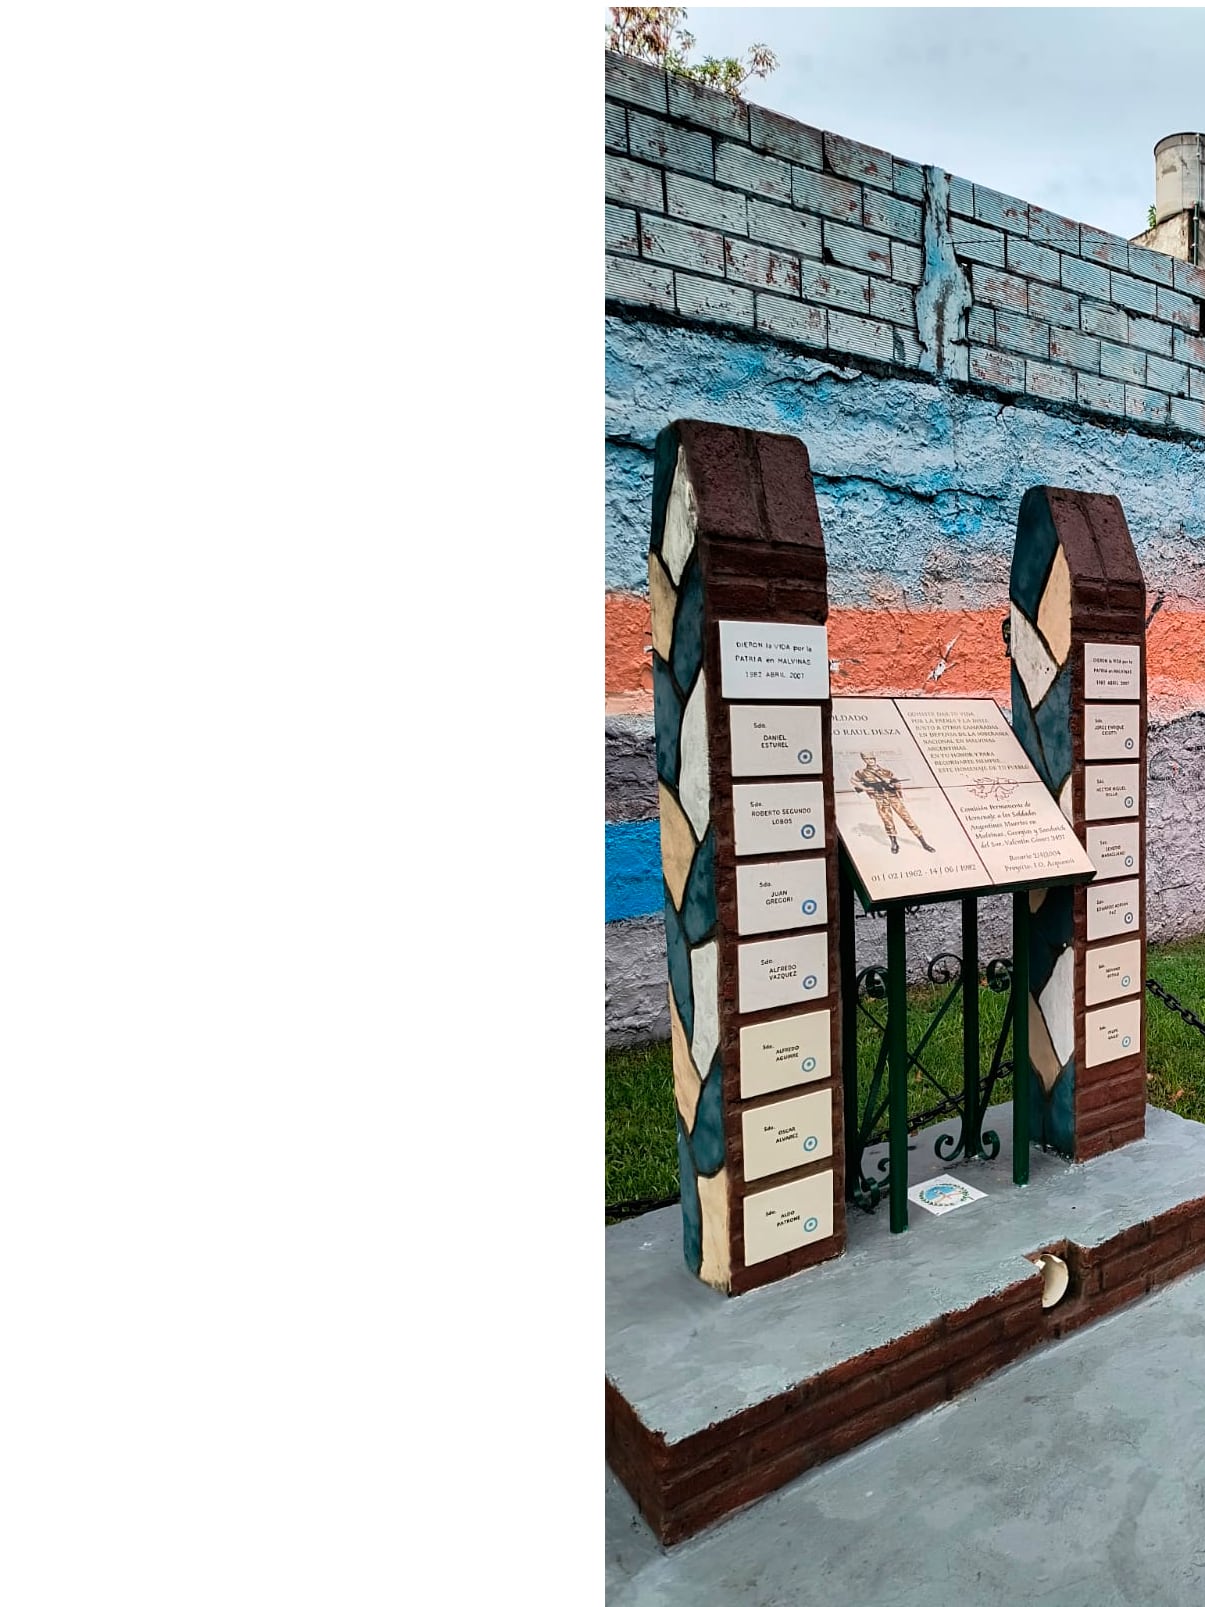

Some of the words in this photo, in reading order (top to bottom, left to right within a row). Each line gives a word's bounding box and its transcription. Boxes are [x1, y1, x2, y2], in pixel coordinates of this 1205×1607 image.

[770, 890, 788, 898] JUAN
[766, 897, 793, 905] GREGORI
[769, 964, 797, 974] ALFREDO
[769, 971, 797, 980] VAZQUEZ
[776, 1045, 800, 1054] ALFREDO
[778, 1126, 796, 1135] OSCAR
[776, 1133, 798, 1144] ALVAREZ
[780, 1210, 795, 1218] ALDO
